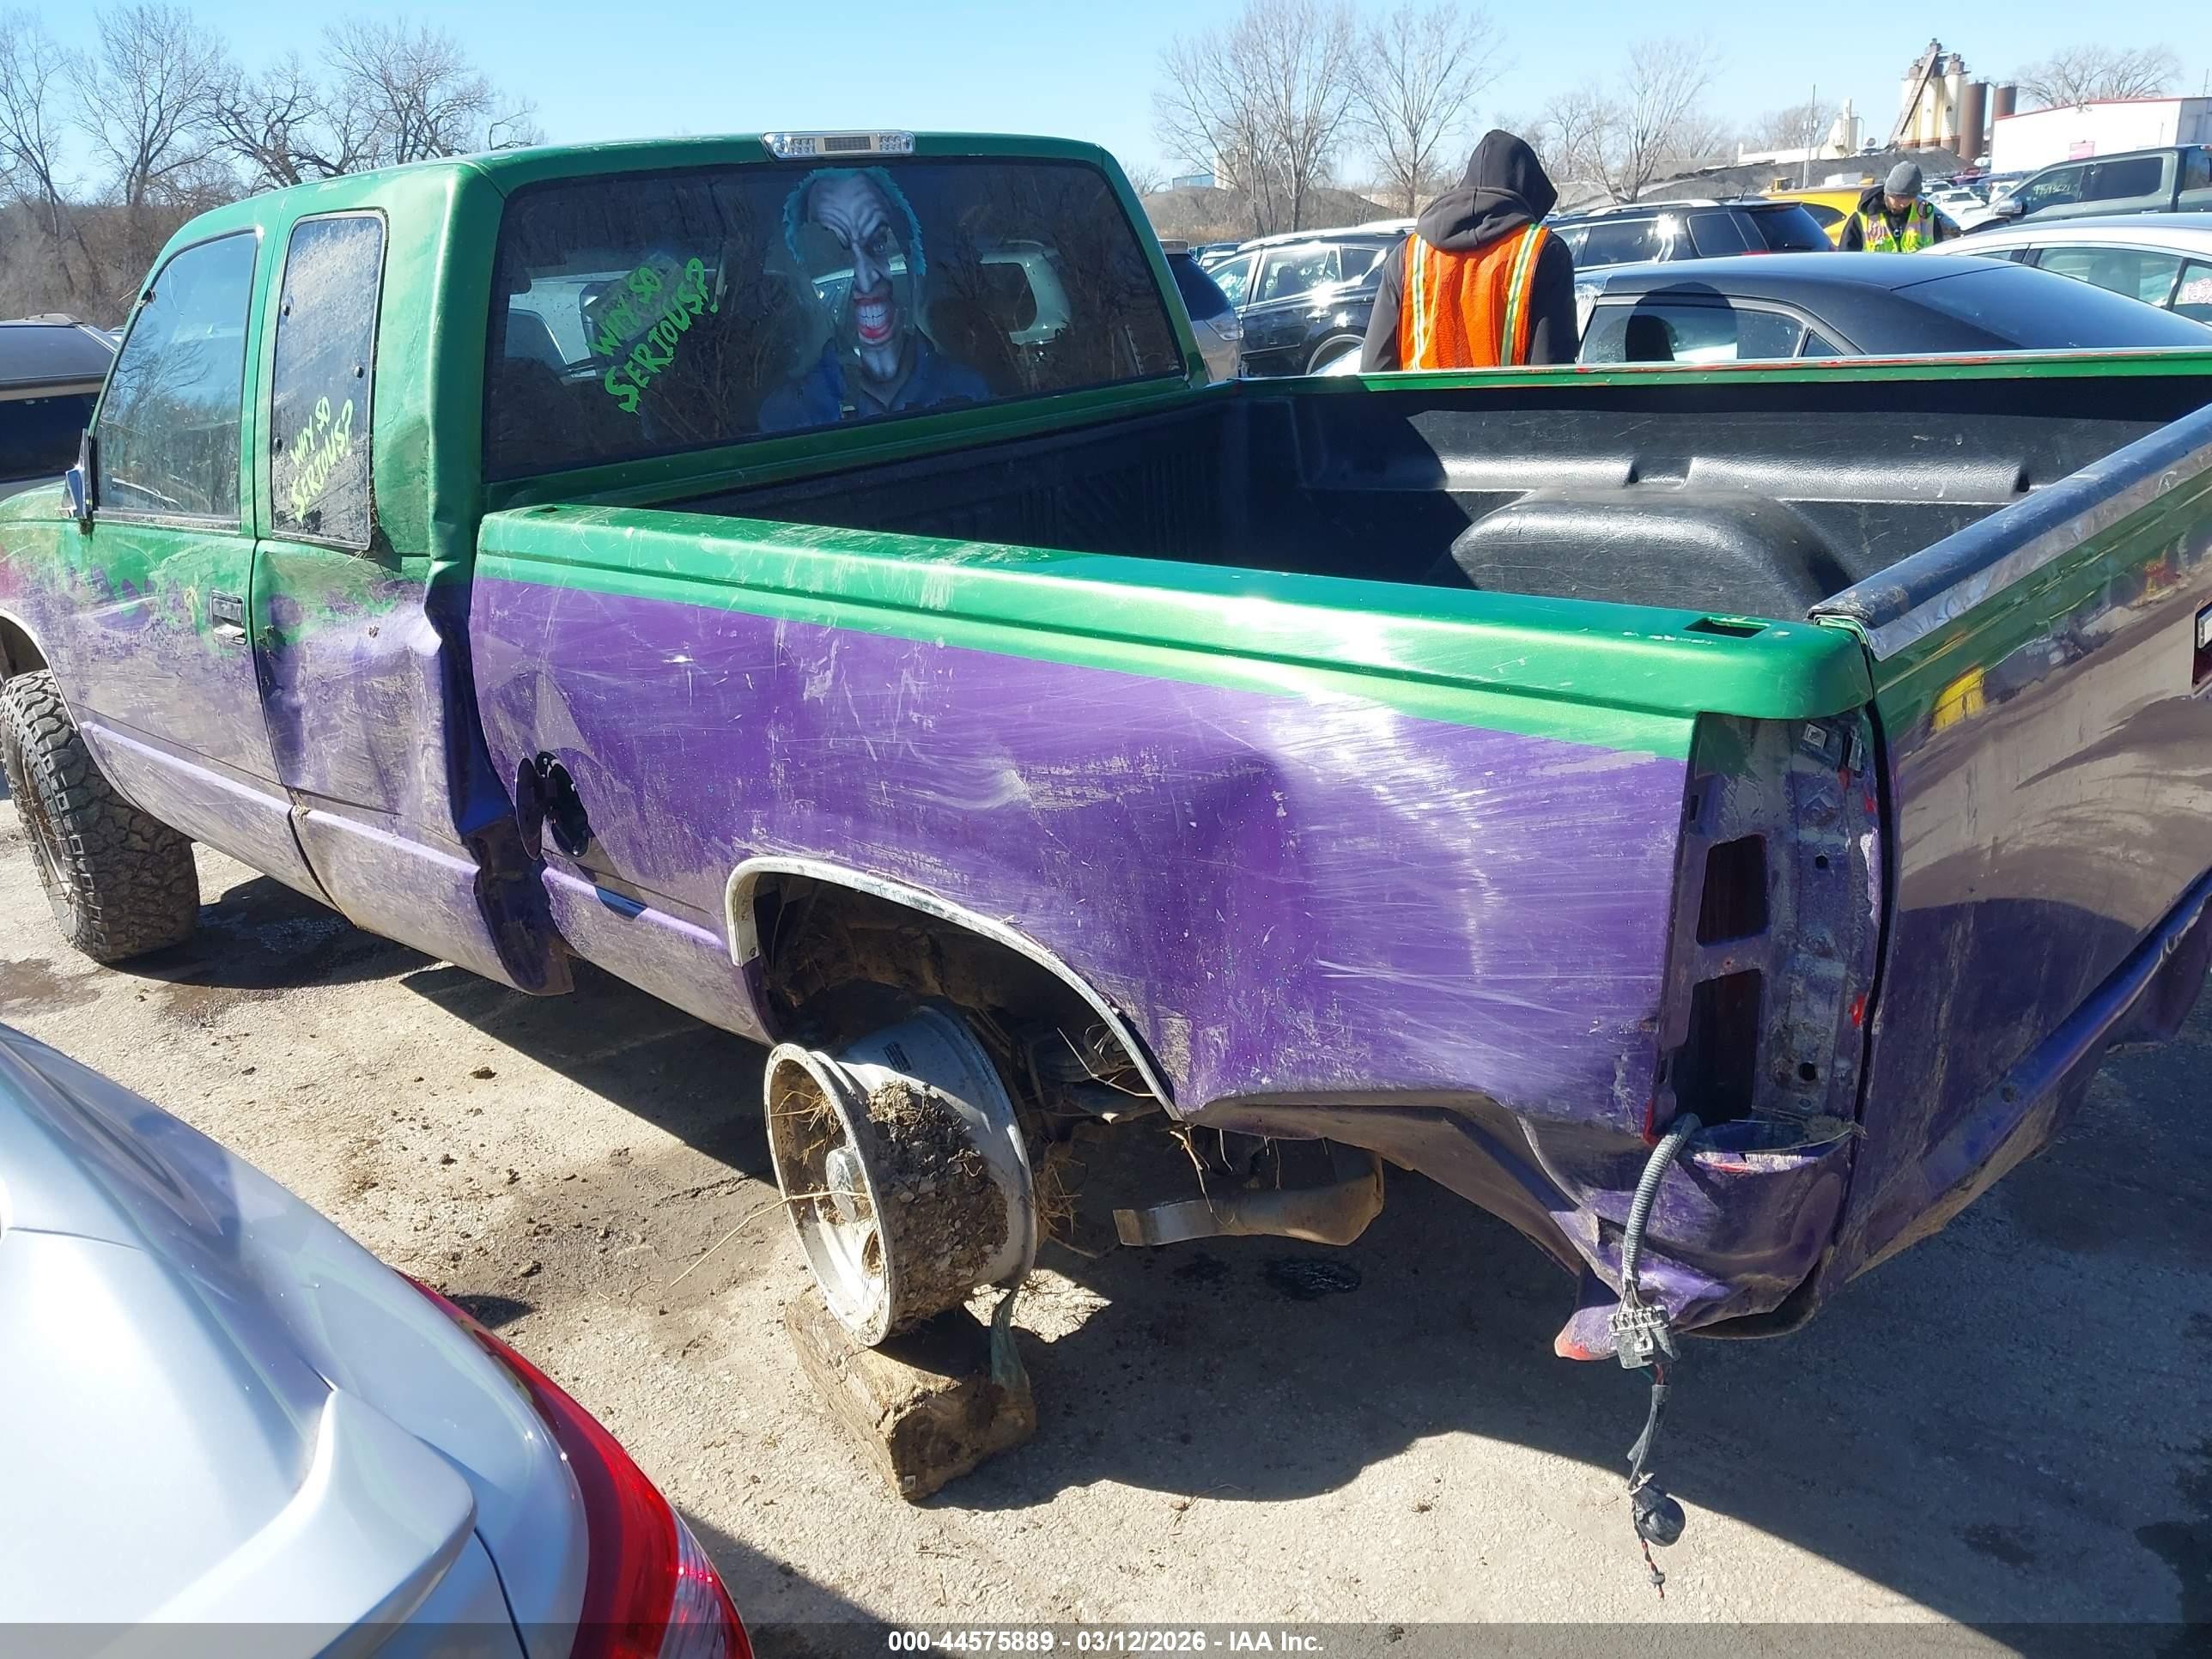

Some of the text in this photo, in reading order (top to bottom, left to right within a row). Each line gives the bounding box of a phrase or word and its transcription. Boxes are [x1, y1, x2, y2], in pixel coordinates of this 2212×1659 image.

[587, 267, 663, 356] WHY SO
[605, 258, 720, 416] SERIOUS?
[289, 396, 331, 467] WHY SO
[292, 398, 354, 527] SERIOUS?
